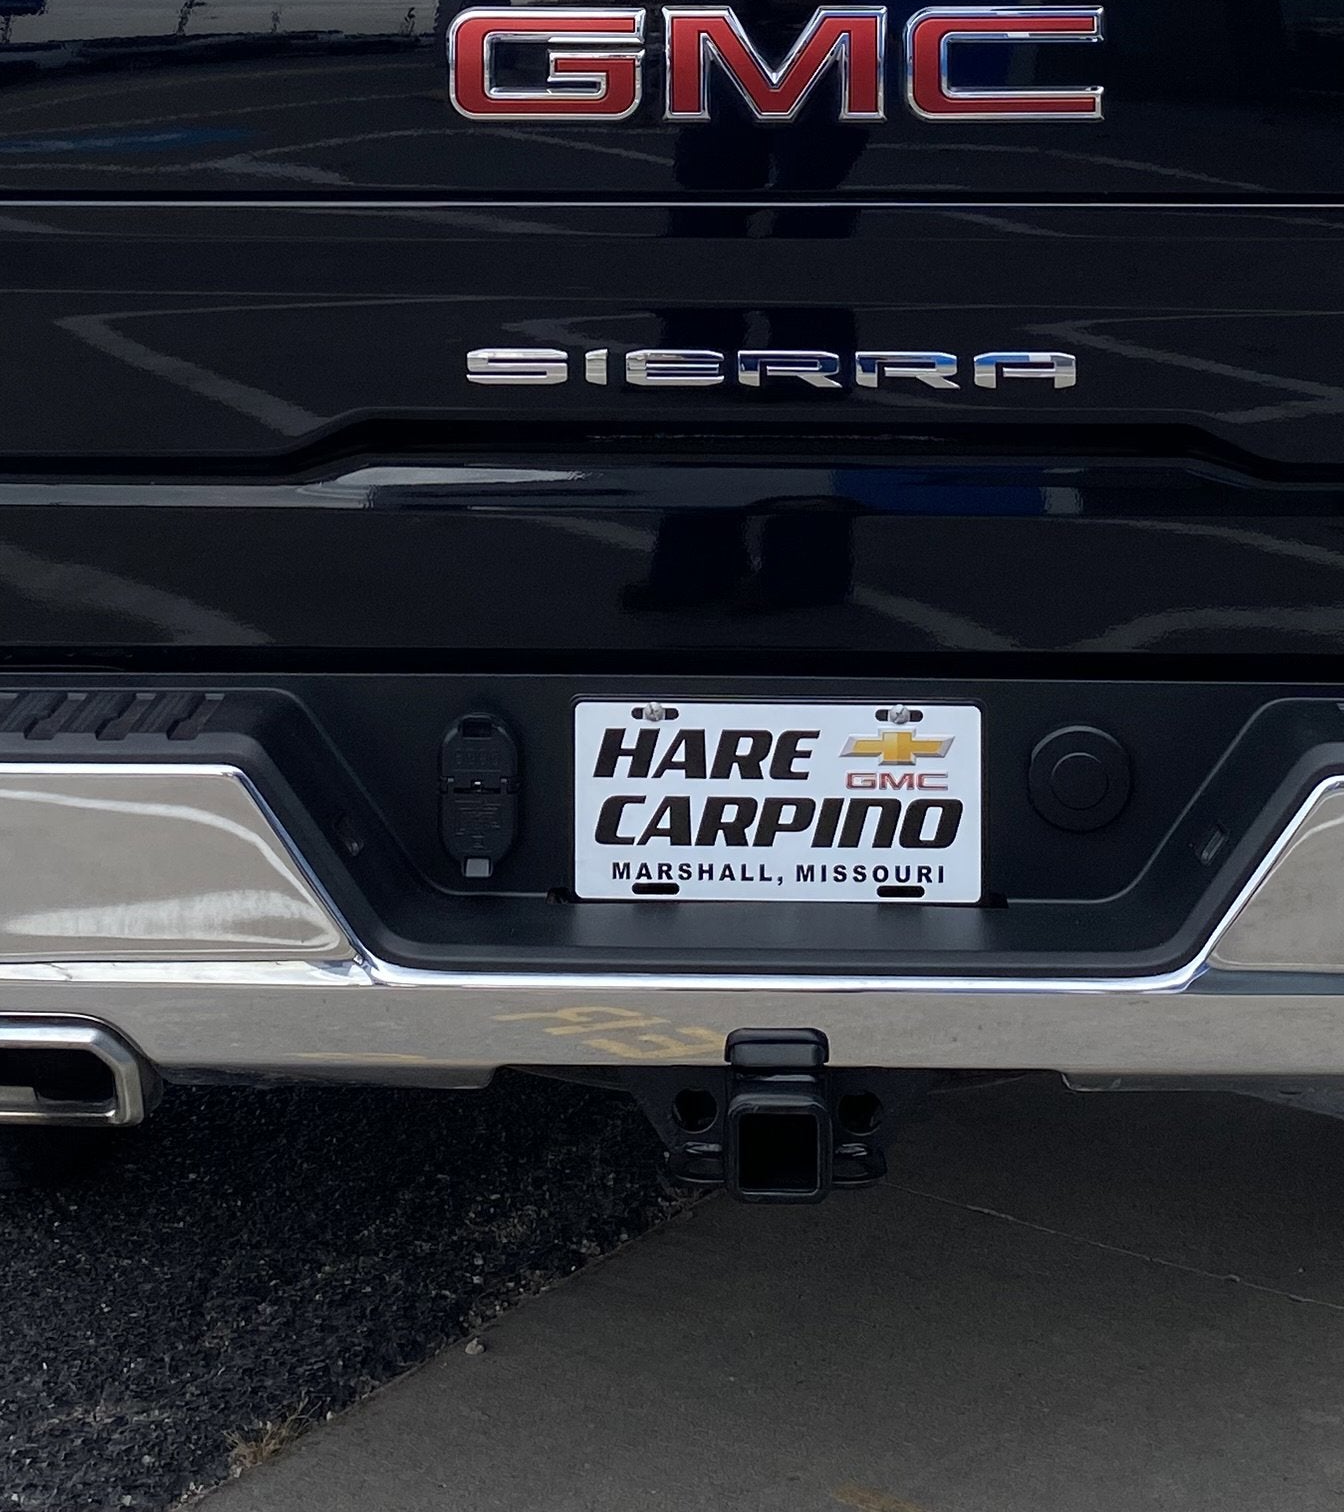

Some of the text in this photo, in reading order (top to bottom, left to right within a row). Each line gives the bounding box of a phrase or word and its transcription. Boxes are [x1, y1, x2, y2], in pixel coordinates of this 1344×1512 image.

[447, 4, 1106, 122] GMC
[465, 348, 1078, 389] SIERRA
[592, 727, 821, 781] HARE
[845, 771, 949, 791] GMC
[593, 794, 964, 849] CARPINO
[611, 862, 945, 886] MARSHALL, MISSOURI
